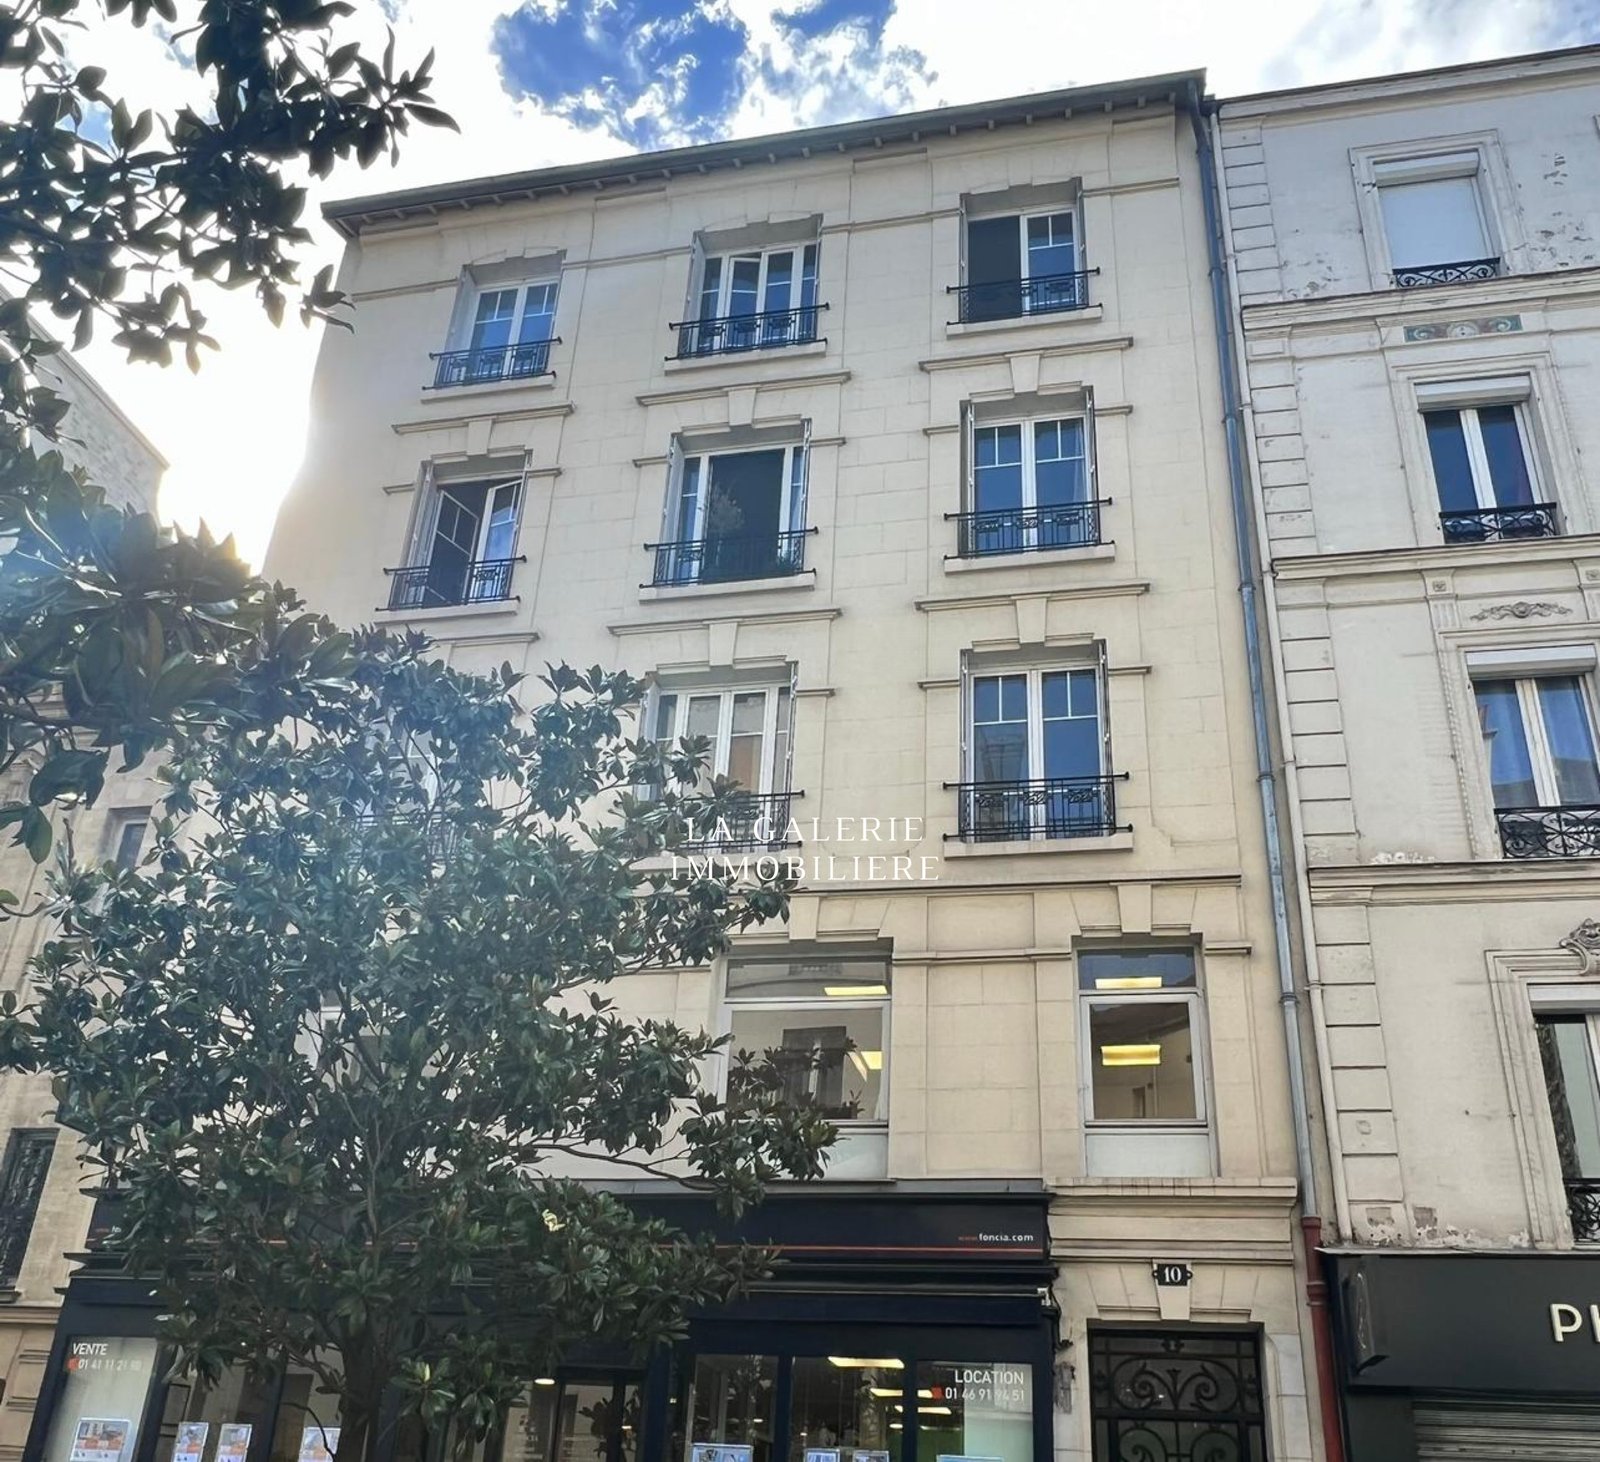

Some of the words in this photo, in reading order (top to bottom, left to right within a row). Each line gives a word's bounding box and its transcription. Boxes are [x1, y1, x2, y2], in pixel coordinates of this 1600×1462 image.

[1164, 1266, 1182, 1282] 10
[72, 1343, 108, 1355] VENTE
[954, 1369, 1024, 1385] LOCATION
[945, 1386, 958, 1399] 01
[962, 1388, 976, 1400] 46
[978, 1388, 991, 1401] 91
[1012, 1389, 1024, 1401] 51
